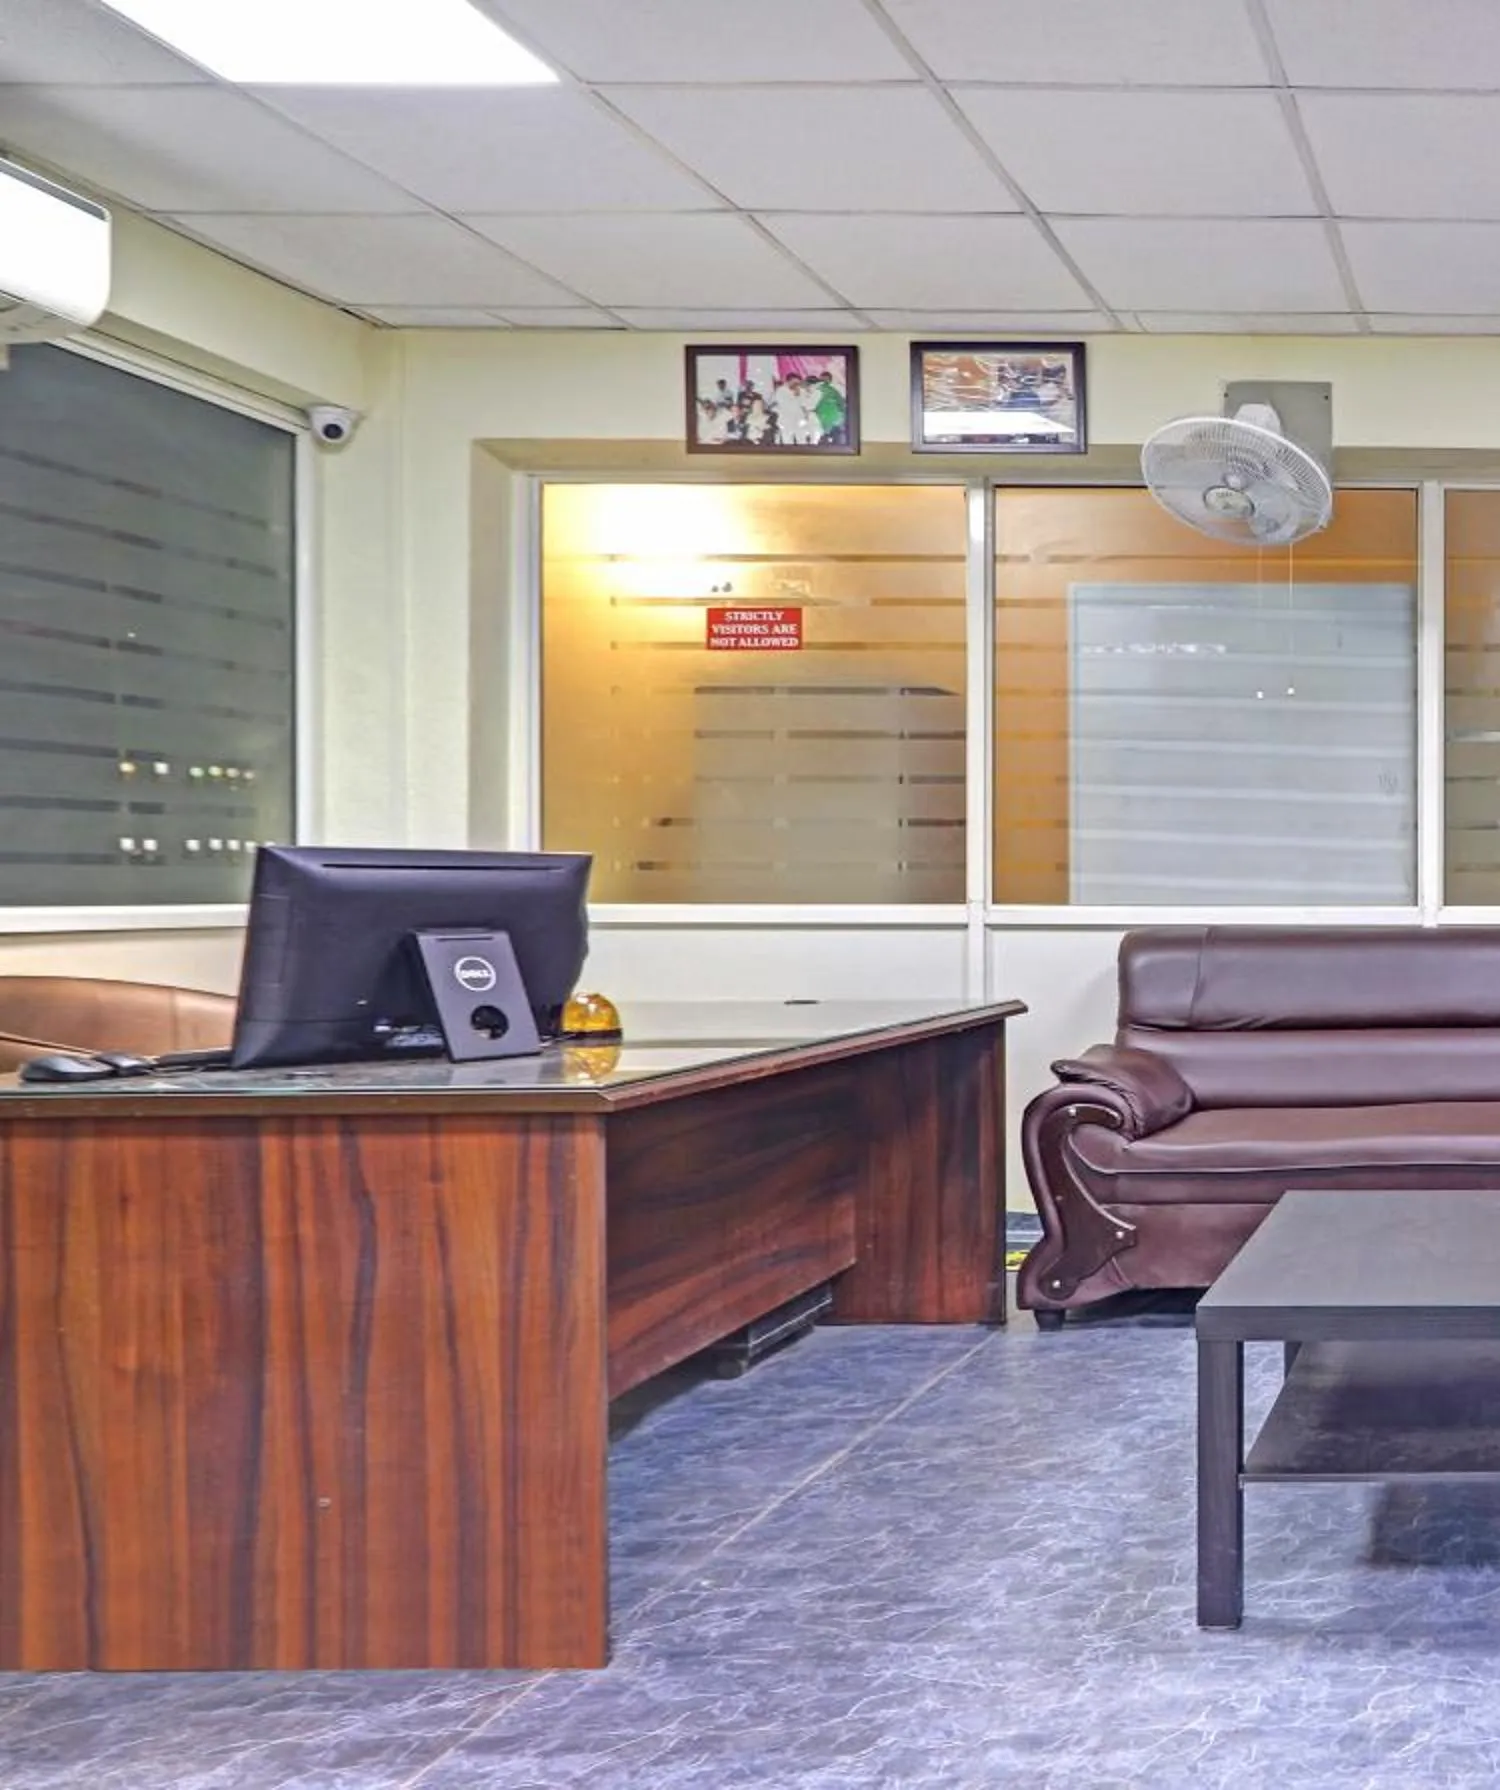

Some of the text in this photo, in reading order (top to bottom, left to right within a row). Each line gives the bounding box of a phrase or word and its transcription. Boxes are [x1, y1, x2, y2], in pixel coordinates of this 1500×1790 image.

[725, 611, 784, 621] STRICTLY
[712, 623, 798, 634] VISITORS ARE
[710, 637, 799, 647] NOT ALLOWED
